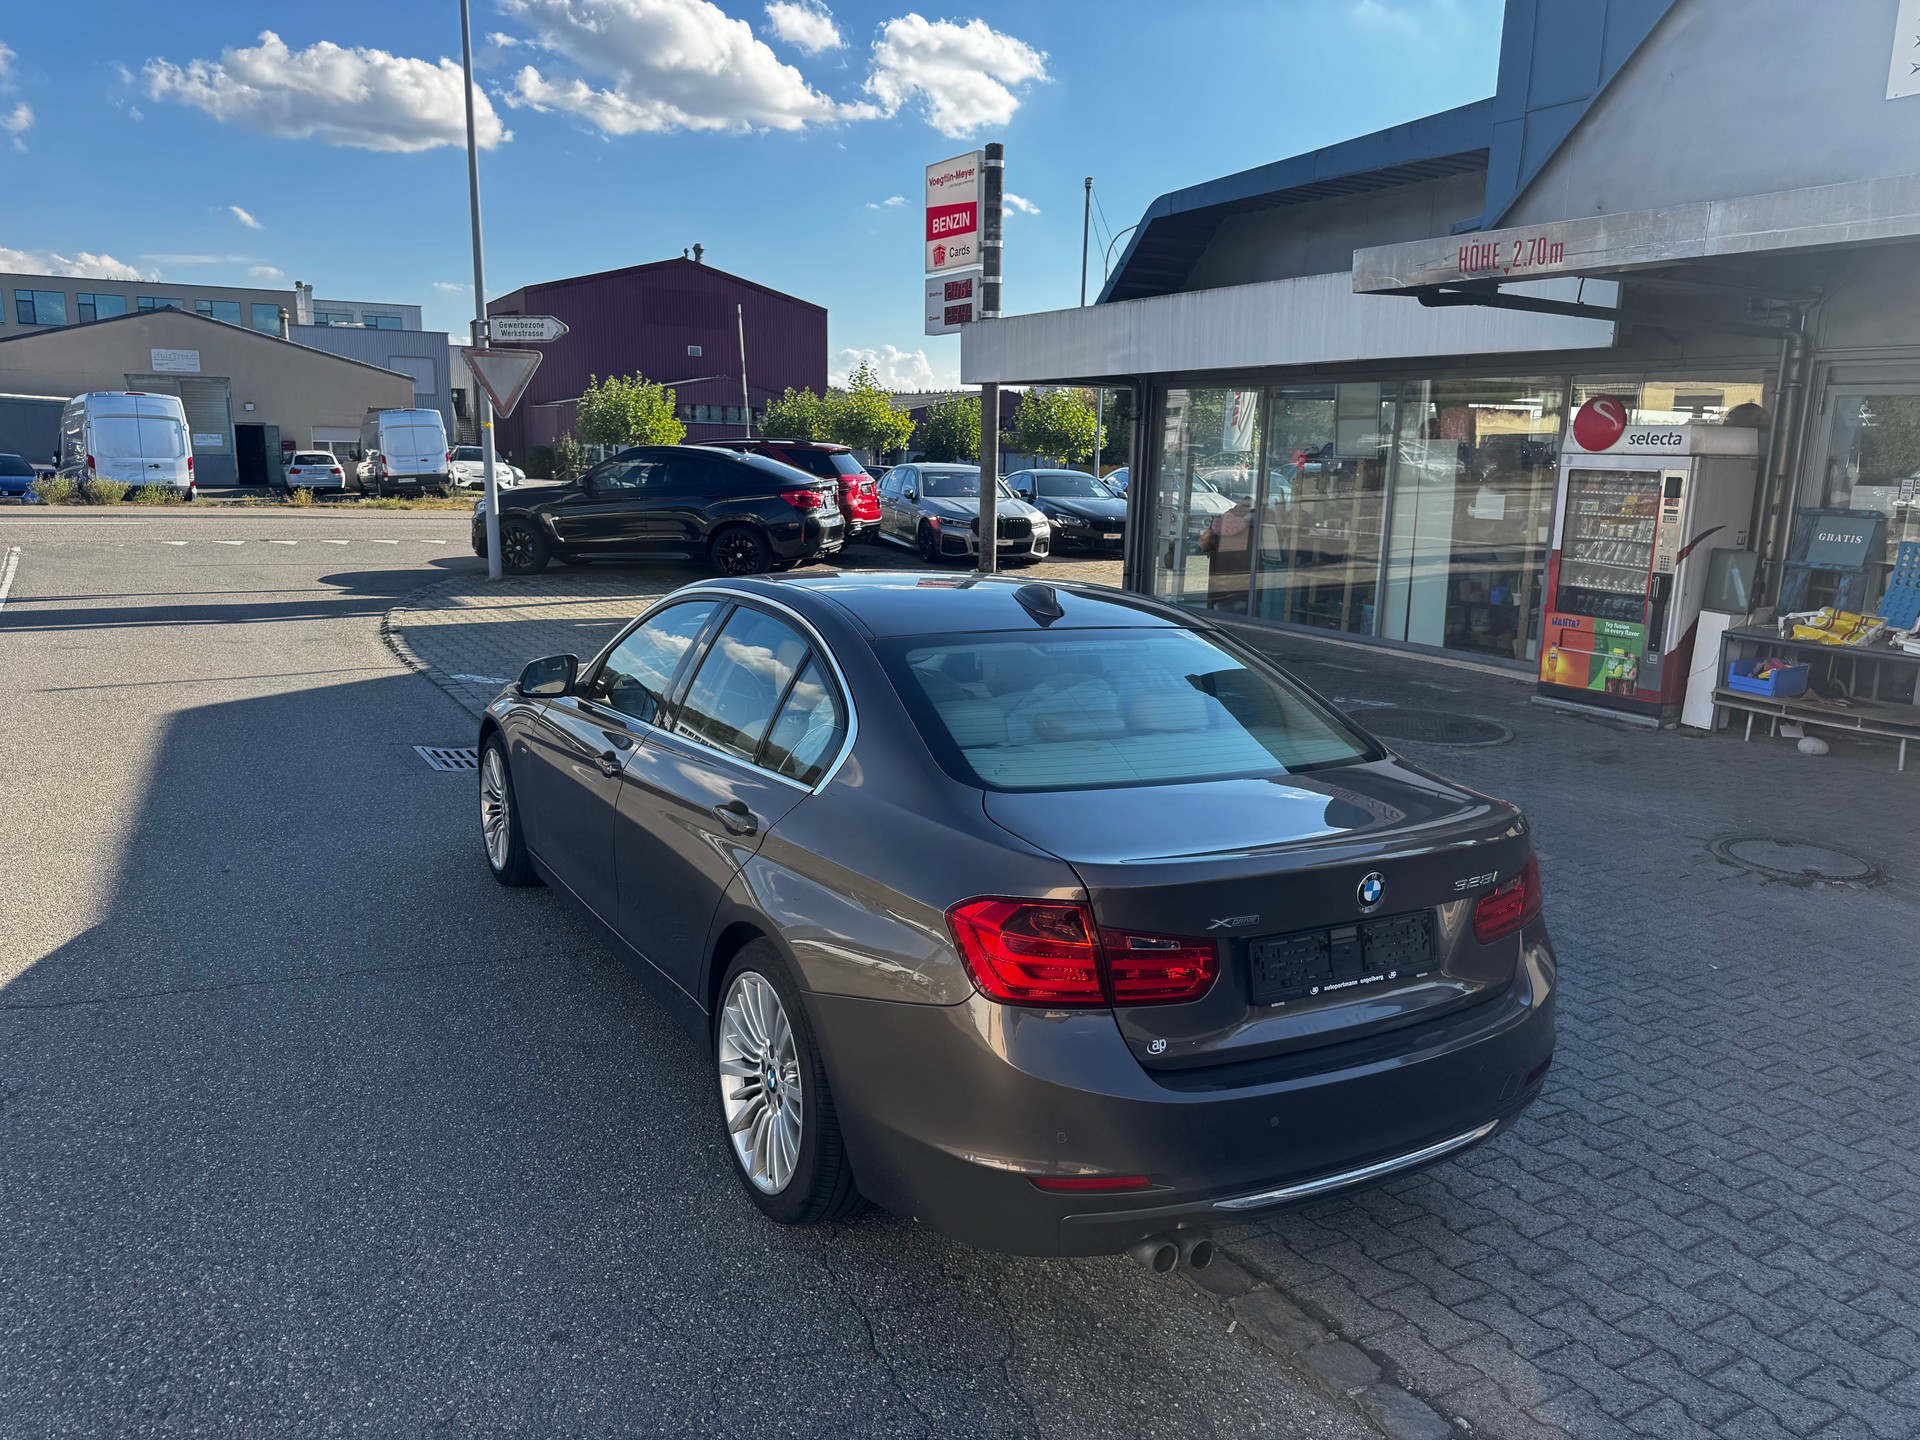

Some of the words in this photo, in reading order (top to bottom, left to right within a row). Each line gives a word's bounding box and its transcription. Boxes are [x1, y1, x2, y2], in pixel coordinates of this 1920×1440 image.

[932, 211, 970, 234] BENZIN
[949, 244, 970, 258] Cards
[1459, 239, 1500, 273] HÖHE
[1628, 431, 1682, 445] selecta
[1818, 532, 1863, 544] GRATIS
[1625, 629, 1640, 637] flavor
[1149, 1038, 1167, 1054] ap
